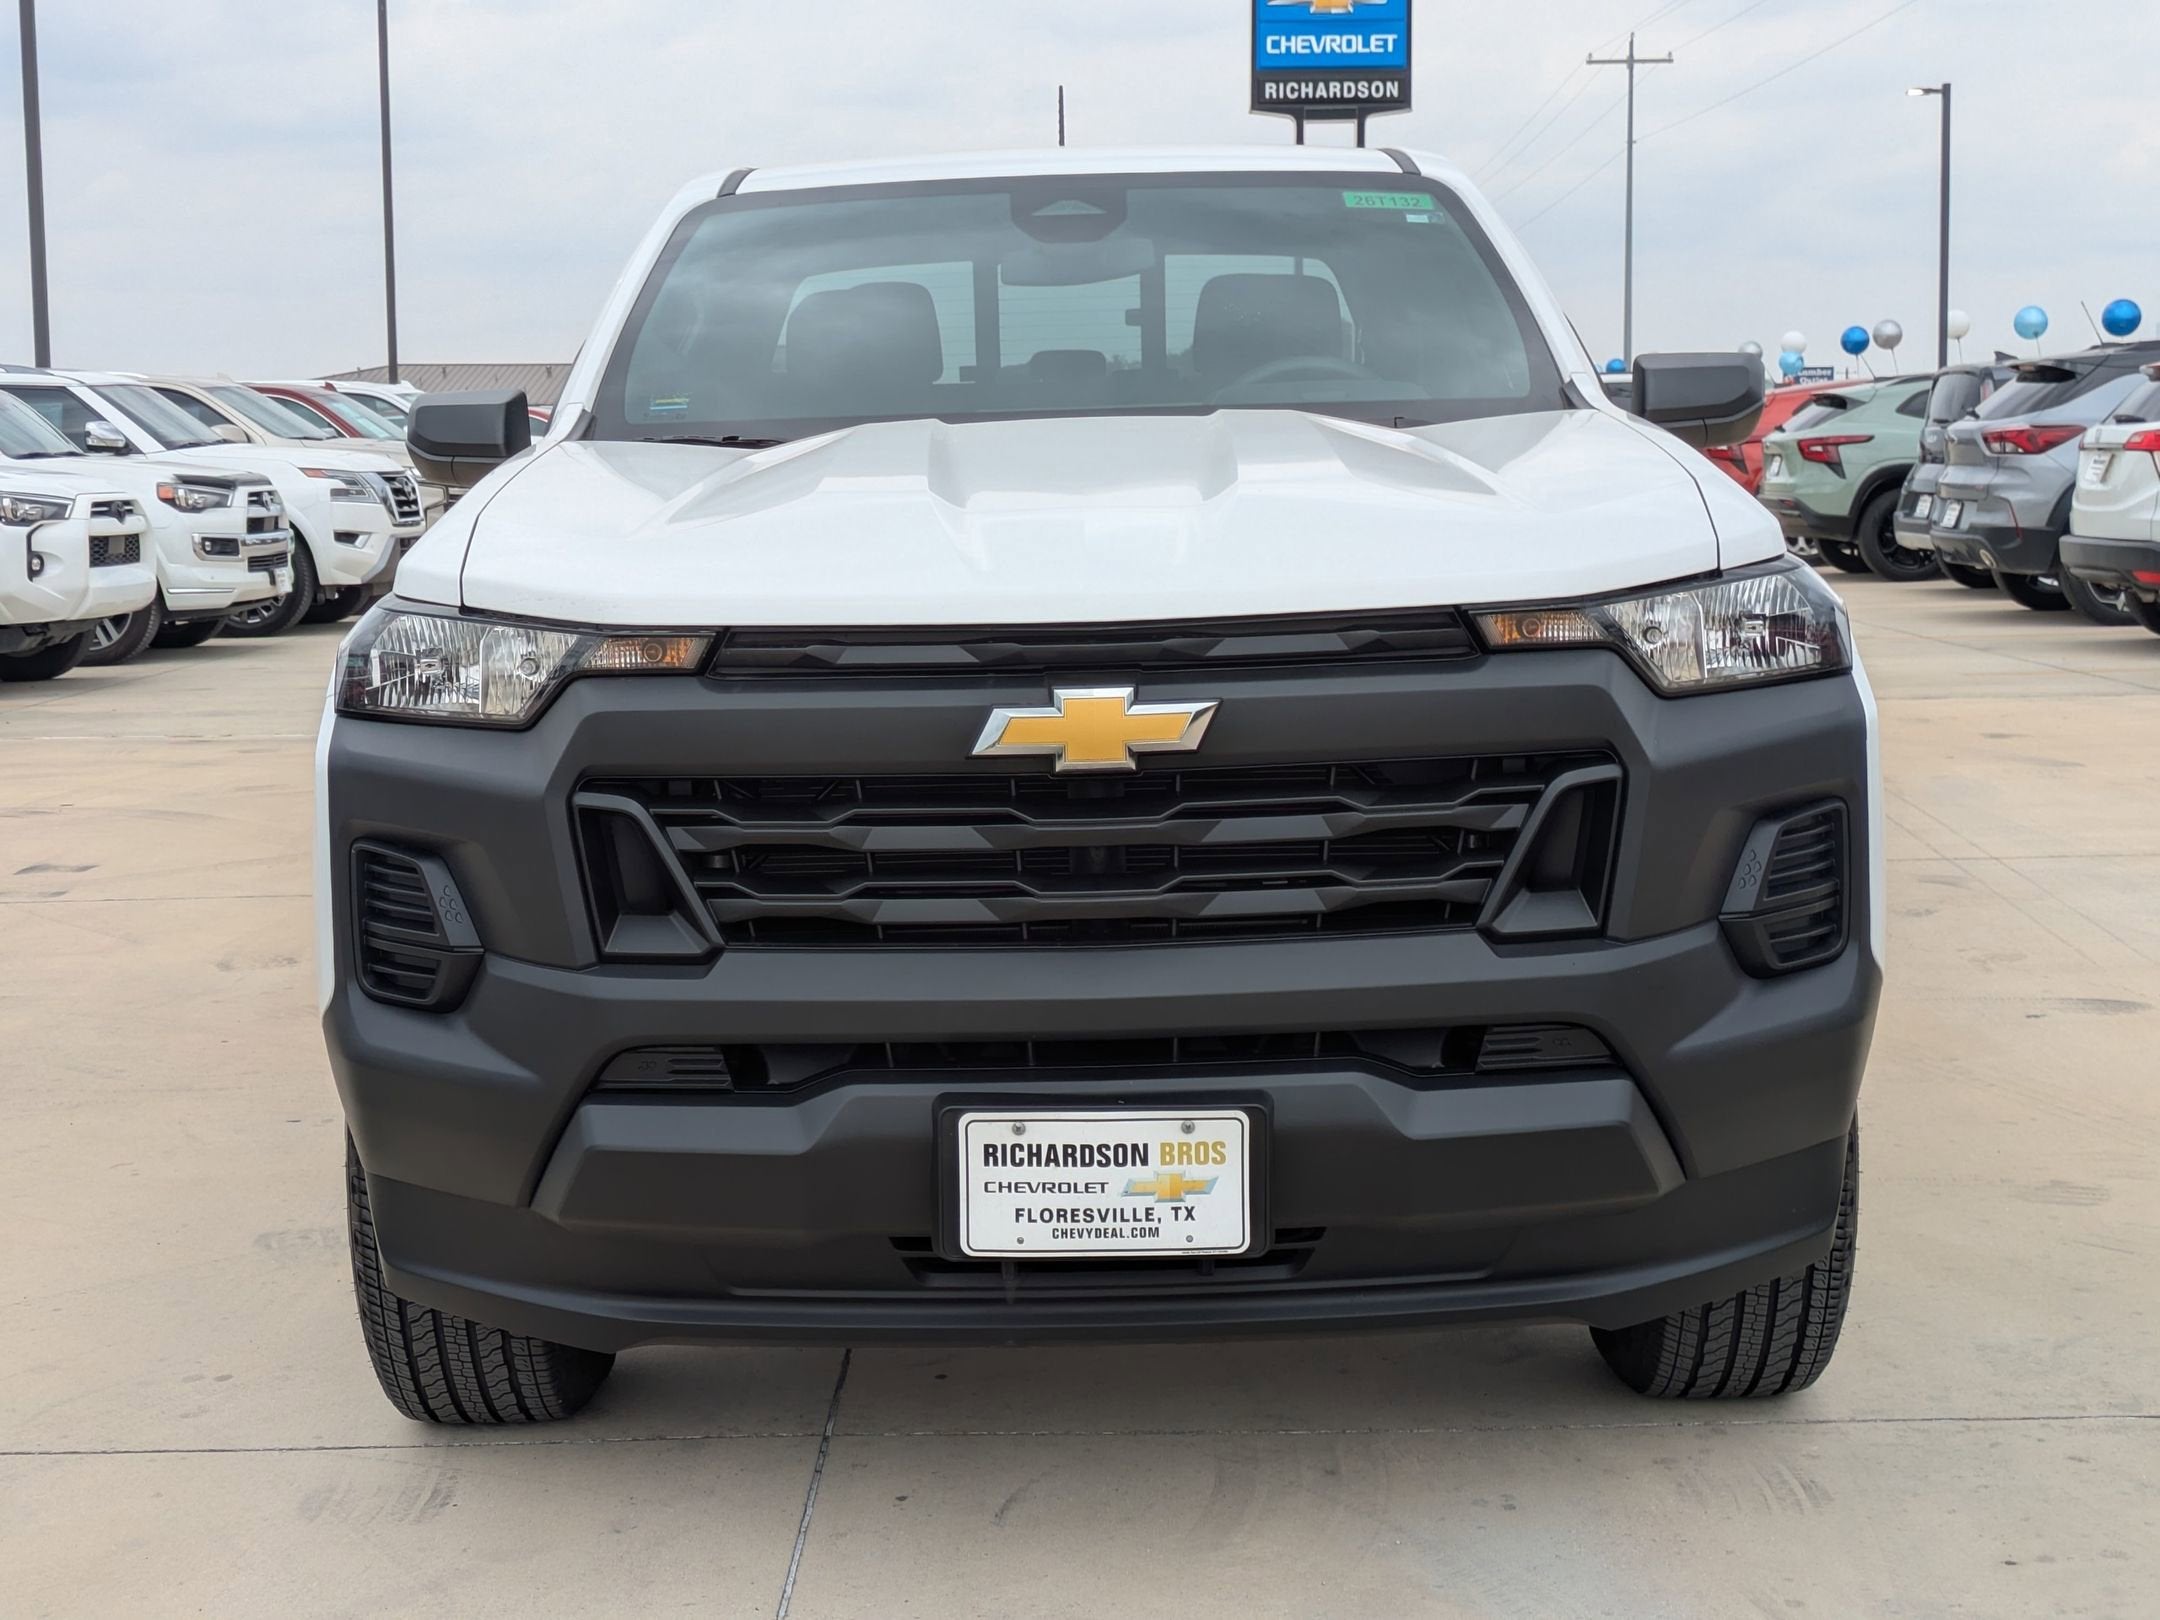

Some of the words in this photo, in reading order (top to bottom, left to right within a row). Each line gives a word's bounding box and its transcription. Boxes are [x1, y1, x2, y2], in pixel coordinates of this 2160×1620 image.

[1266, 34, 1398, 54] CHEVROLET
[1264, 81, 1399, 99] RICHARDSON
[1353, 194, 1422, 208] 26T132
[983, 1143, 1149, 1168] RICHARDSON
[1159, 1141, 1227, 1166] BROS
[984, 1181, 1109, 1194] CHEVROLET
[1015, 1207, 1162, 1224] FLORESVILLE,
[1171, 1206, 1196, 1222] TX
[1051, 1226, 1160, 1240] CHEVYDEAL.COM
